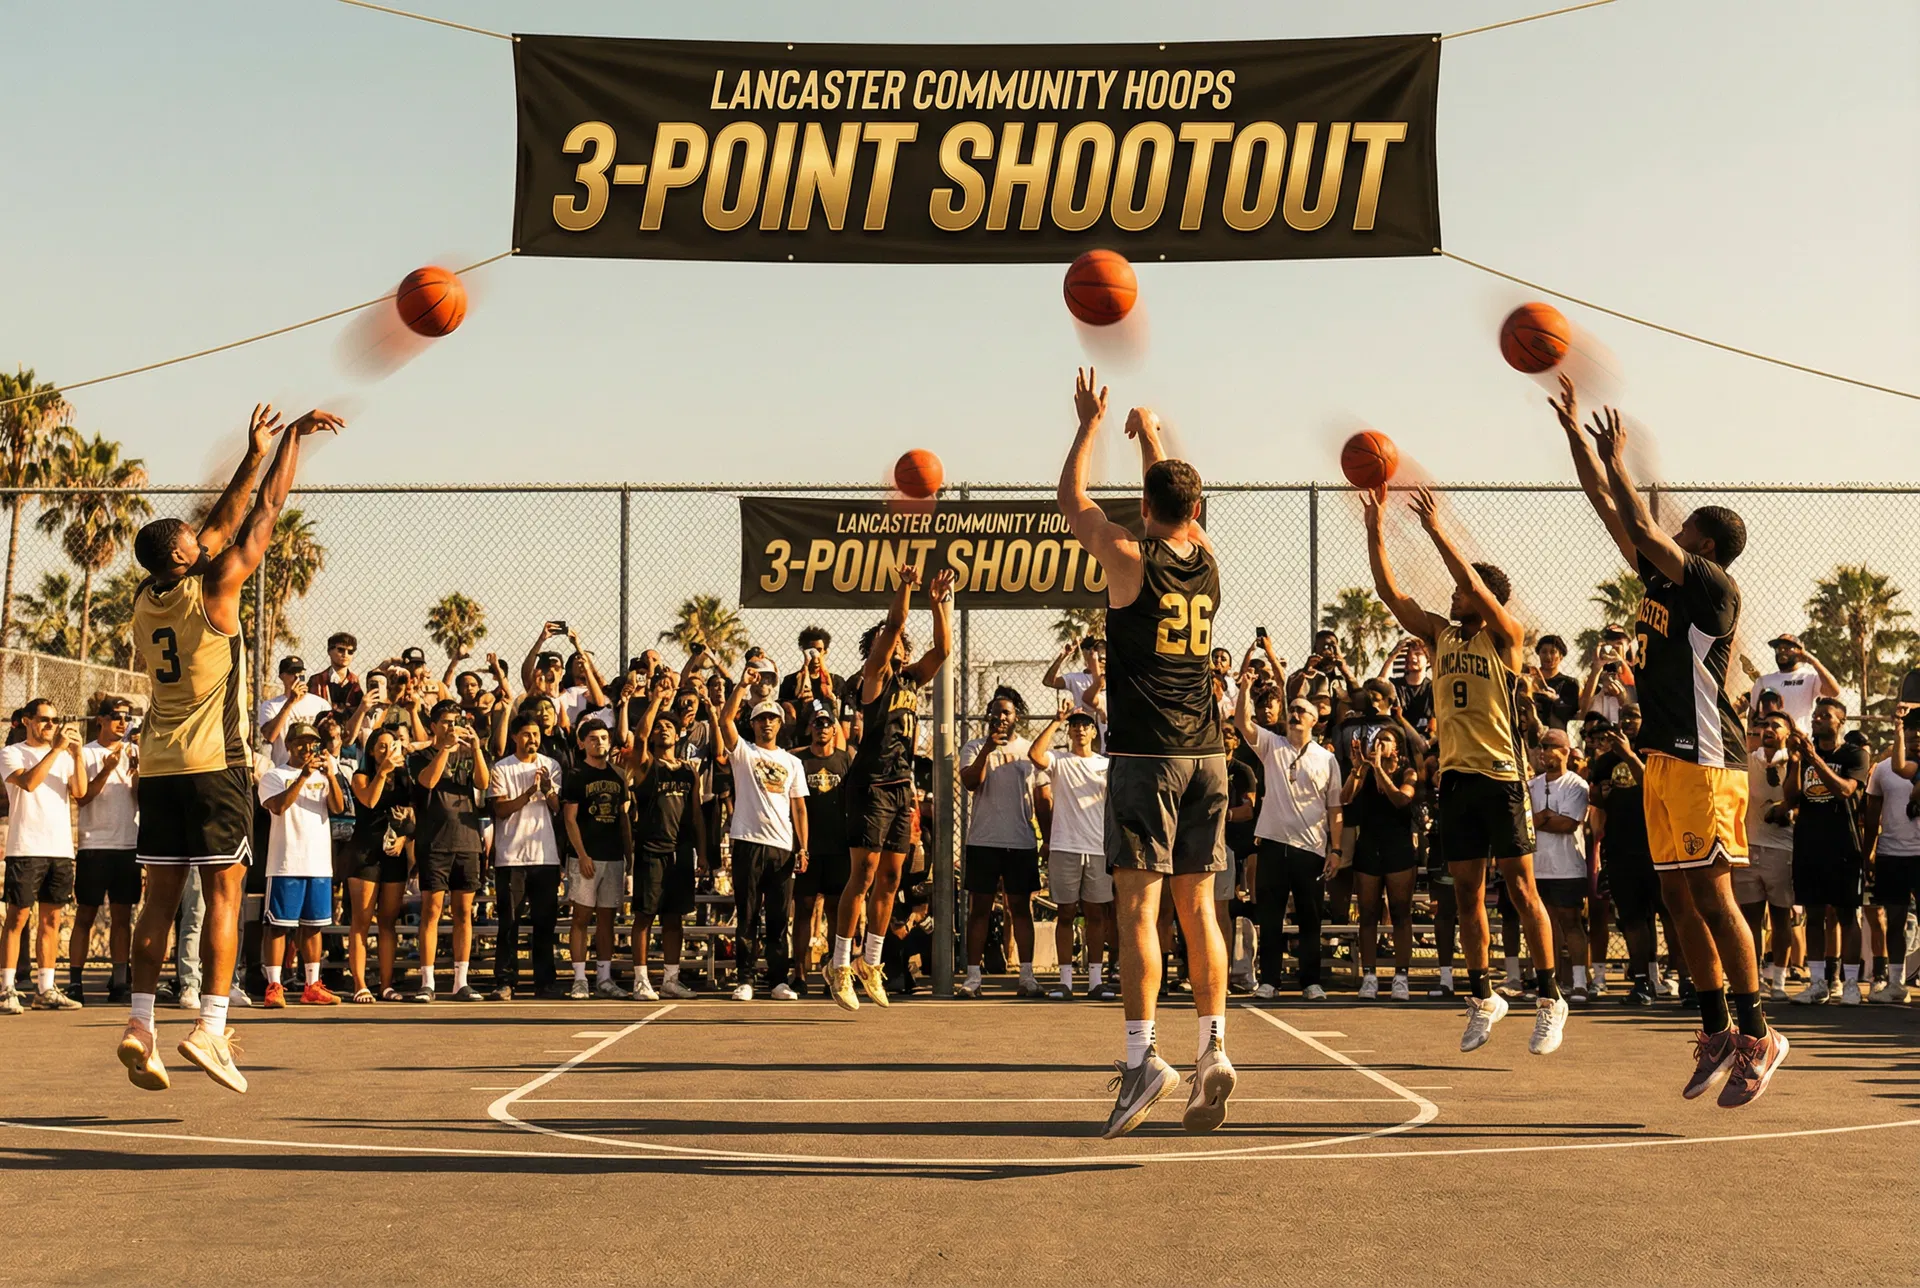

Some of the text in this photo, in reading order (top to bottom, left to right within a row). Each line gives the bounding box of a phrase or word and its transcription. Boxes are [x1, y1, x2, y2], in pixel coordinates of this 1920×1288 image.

[710, 69, 1236, 111] LANCASTER COMMUNITY HOOPS
[552, 120, 1409, 232] 3-POINT SHOOTOUT
[836, 512, 1073, 535] LANCASTER COMMUNITY HOO
[760, 538, 1108, 593] 3-POINT SHOOTO
[1155, 592, 1213, 656] 26
[151, 625, 181, 684] 3
[1453, 681, 1468, 708] 9
